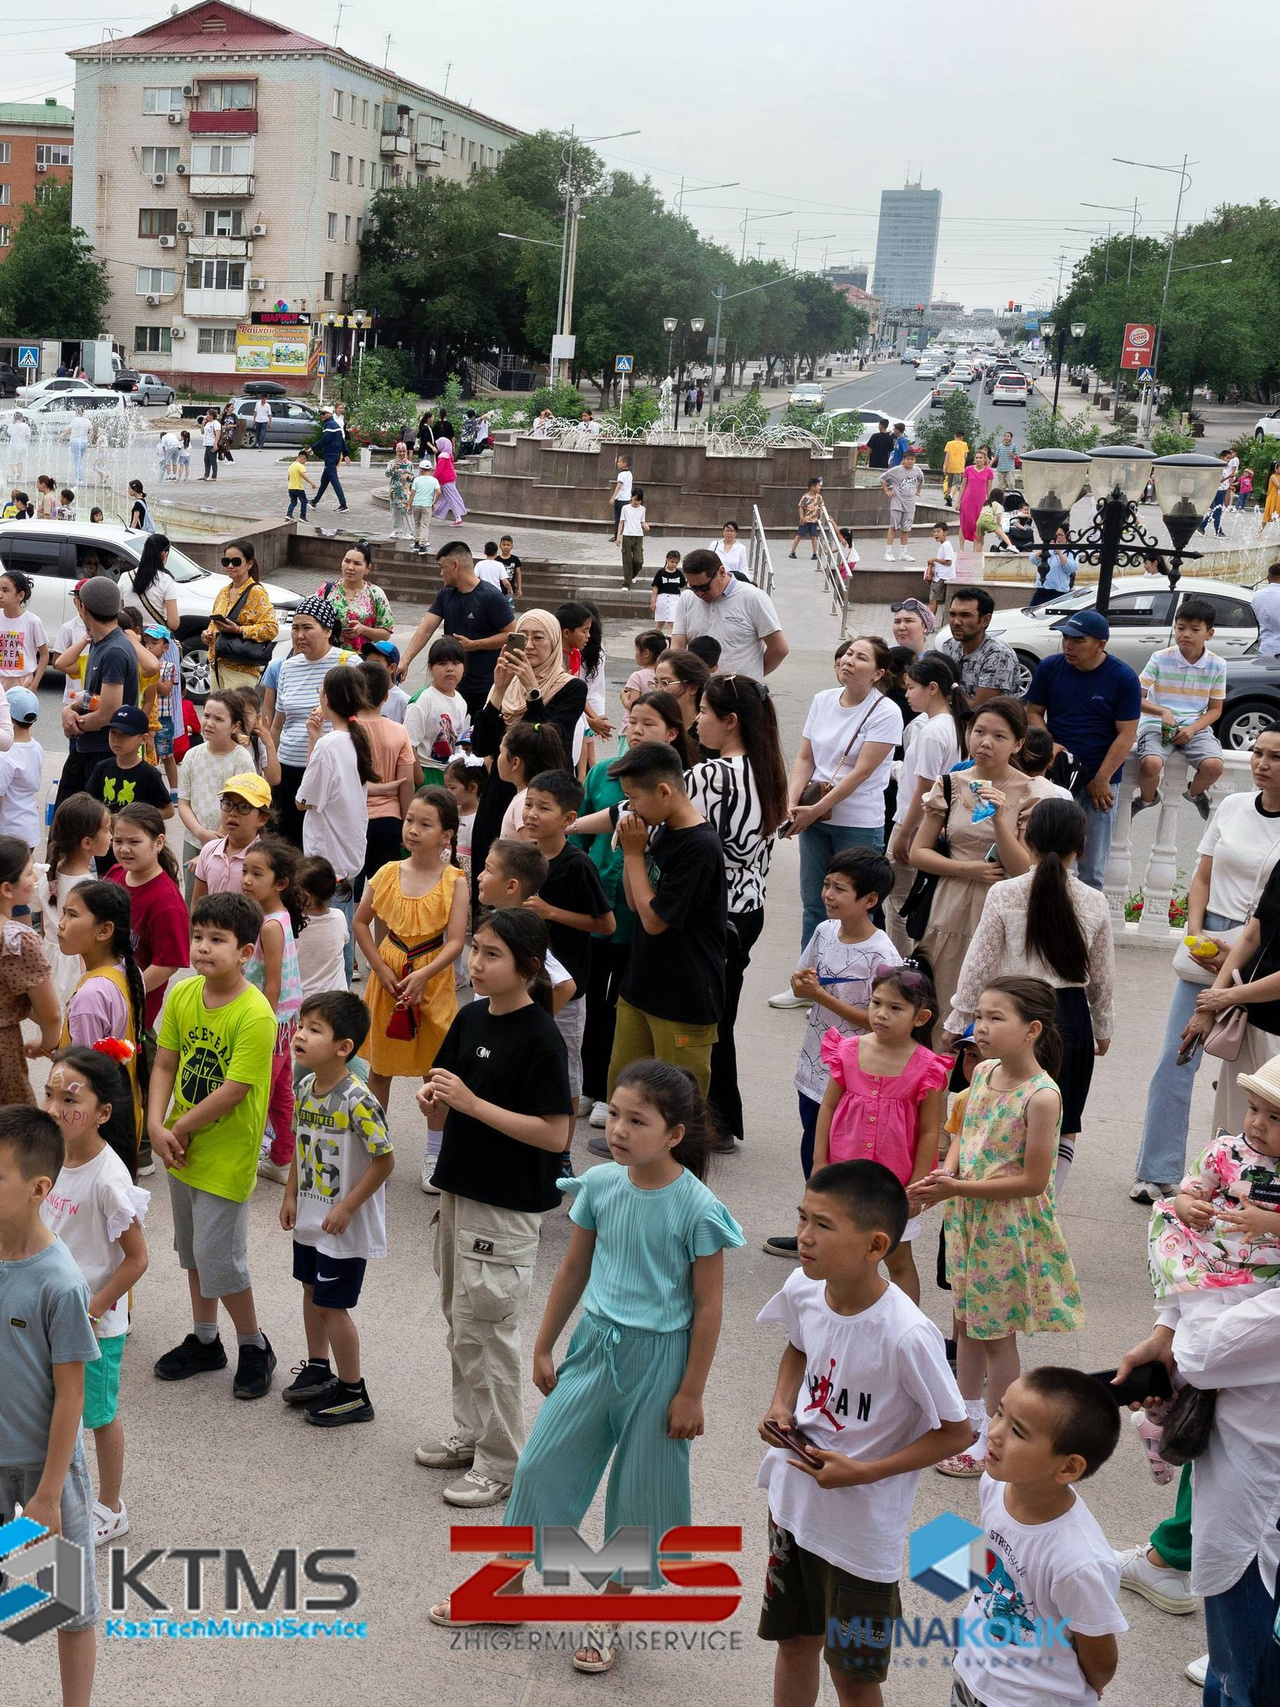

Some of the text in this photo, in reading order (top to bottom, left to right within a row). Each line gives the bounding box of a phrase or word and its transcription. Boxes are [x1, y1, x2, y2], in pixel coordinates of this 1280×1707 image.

[261, 313, 298, 323] ШАРИКИ
[239, 325, 275, 334] Райхан
[0, 639, 20, 648] STAY
[0, 649, 21, 658] CREA
[0, 660, 19, 668] TIVE
[479, 1242, 489, 1250] 77
[989, 1529, 1013, 1557] STREET
